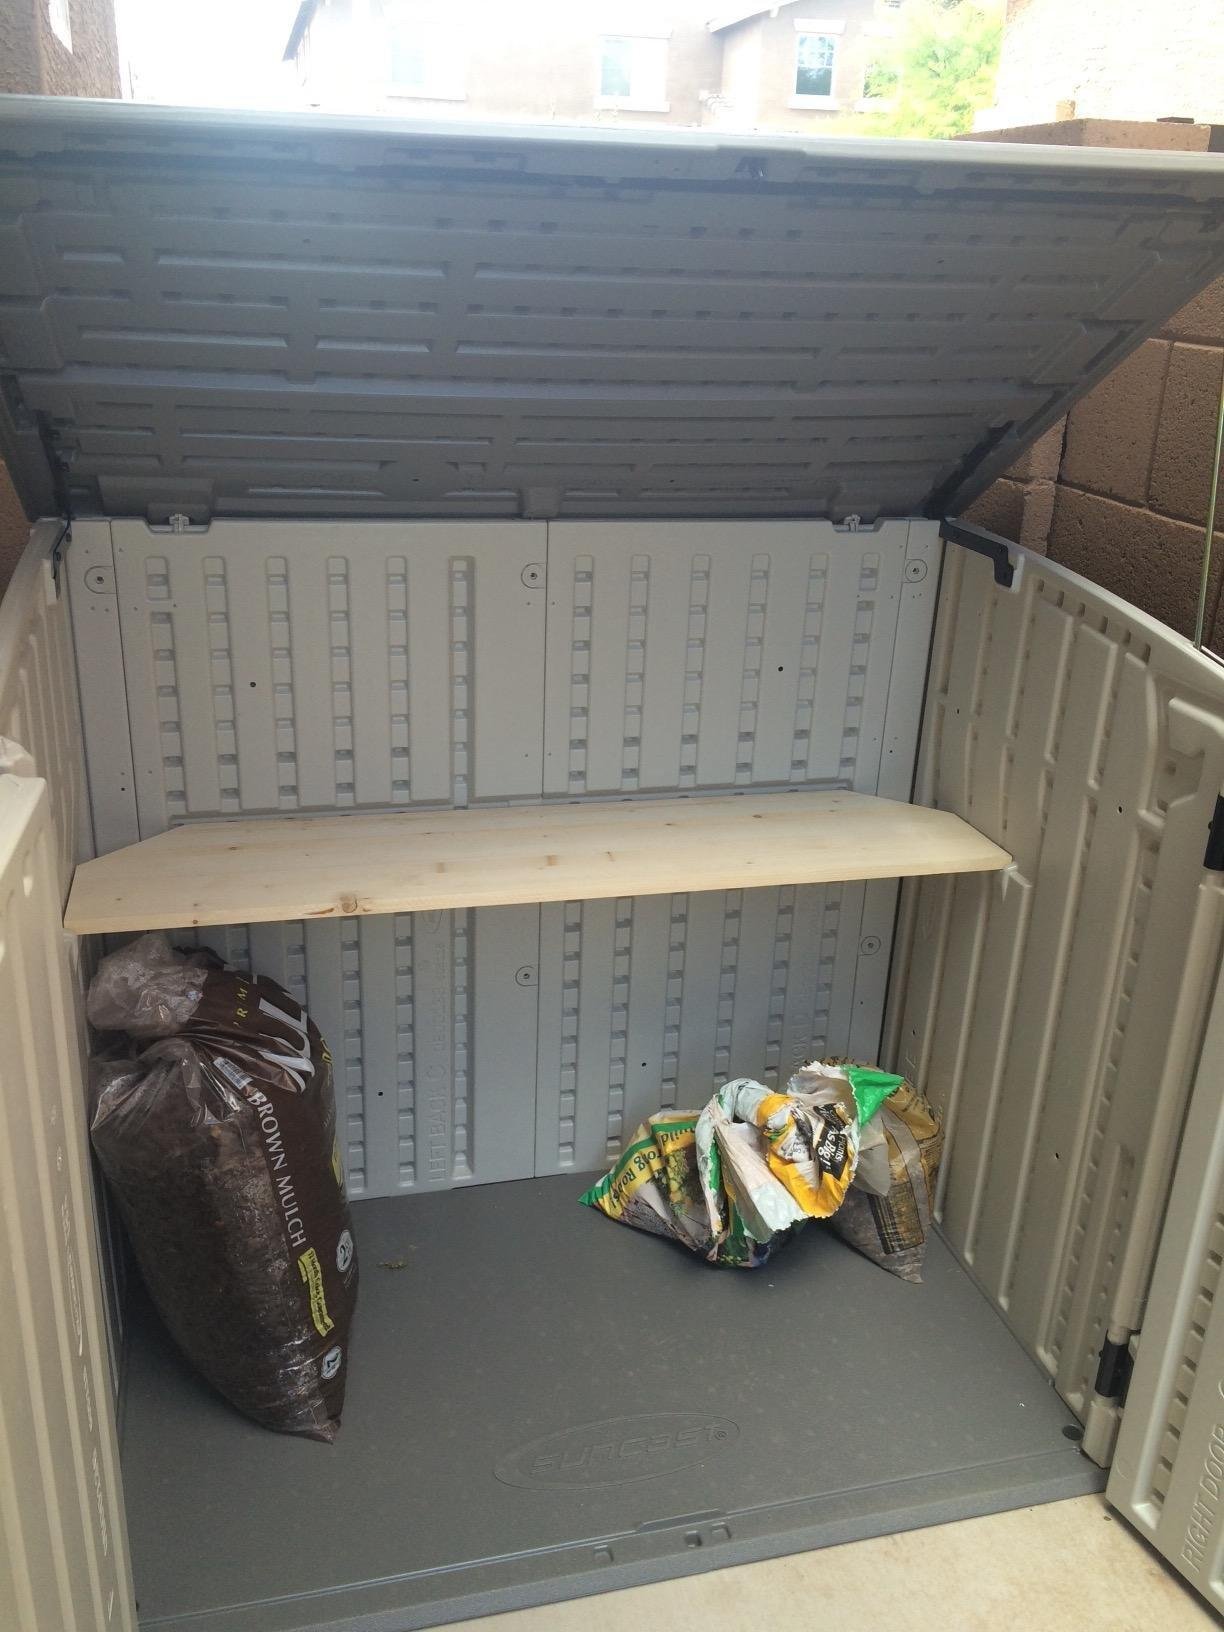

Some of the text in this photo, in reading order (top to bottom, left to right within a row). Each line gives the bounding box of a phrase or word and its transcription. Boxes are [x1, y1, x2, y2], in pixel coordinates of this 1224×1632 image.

[246, 1087, 307, 1249] BROWN MULCH
[1180, 1493, 1216, 1573] RIGHT
